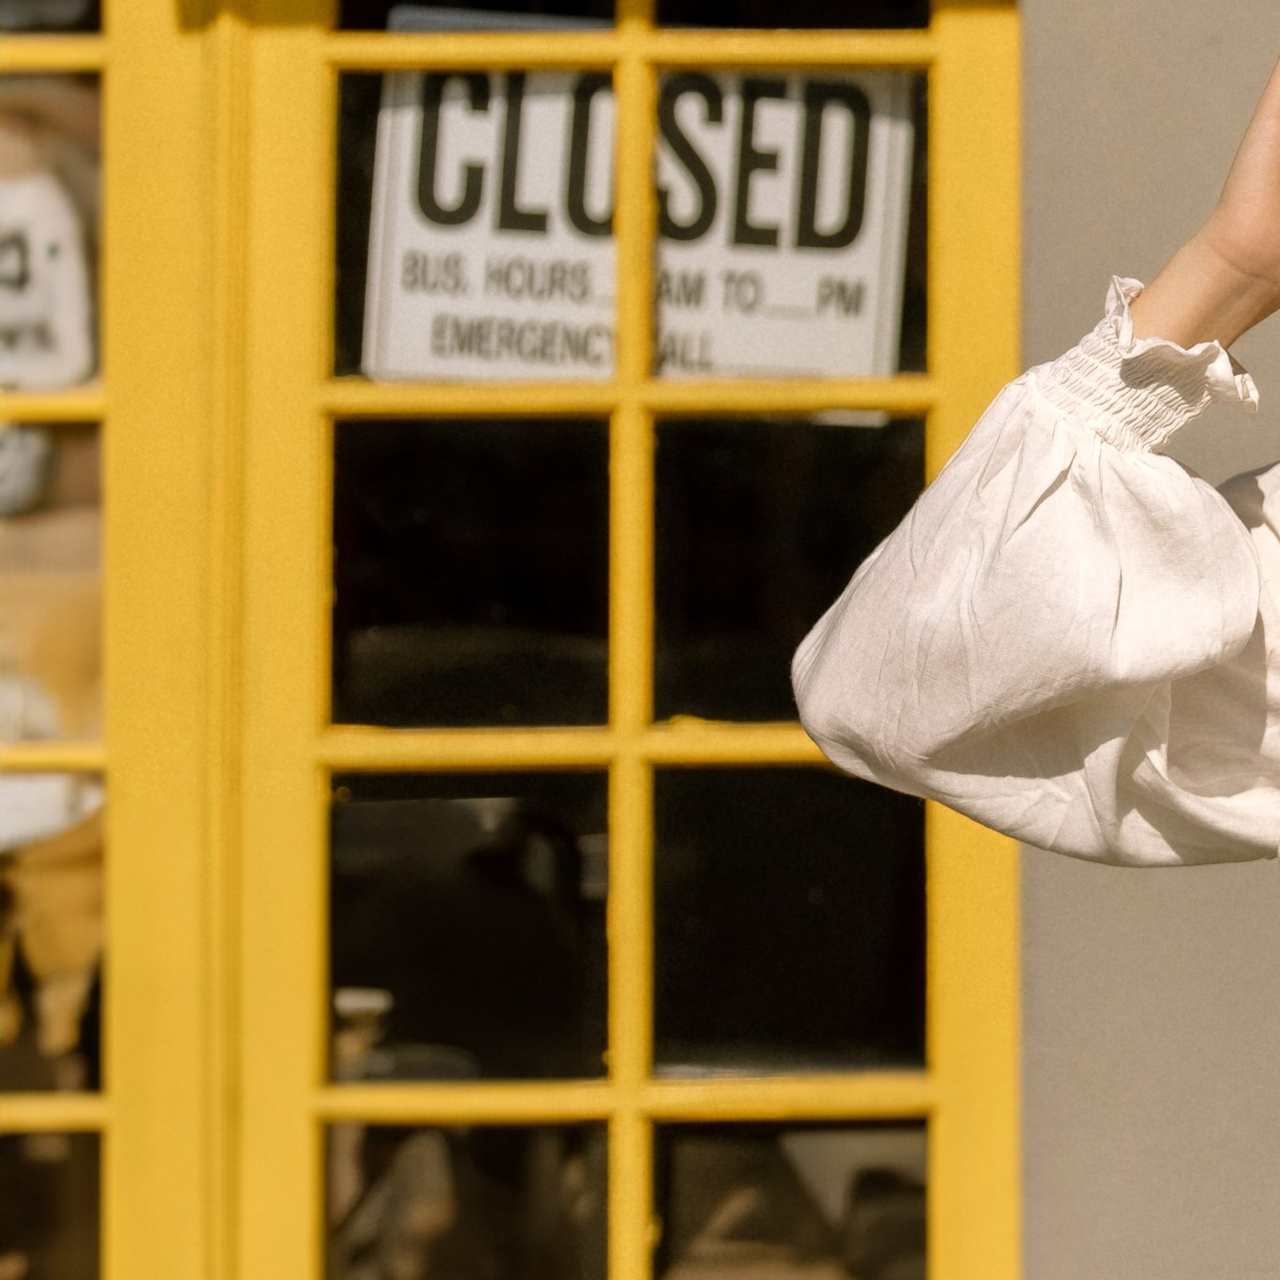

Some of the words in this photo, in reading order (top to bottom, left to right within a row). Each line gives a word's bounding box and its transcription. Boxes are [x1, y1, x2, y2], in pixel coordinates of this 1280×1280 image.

[416, 71, 871, 249] CLOSED
[402, 250, 466, 297] BUS.
[484, 256, 590, 304] HOURS
[656, 271, 704, 309] AM
[722, 270, 764, 317] TO
[815, 276, 865, 318] PM
[430, 314, 615, 368] EMERGENC
